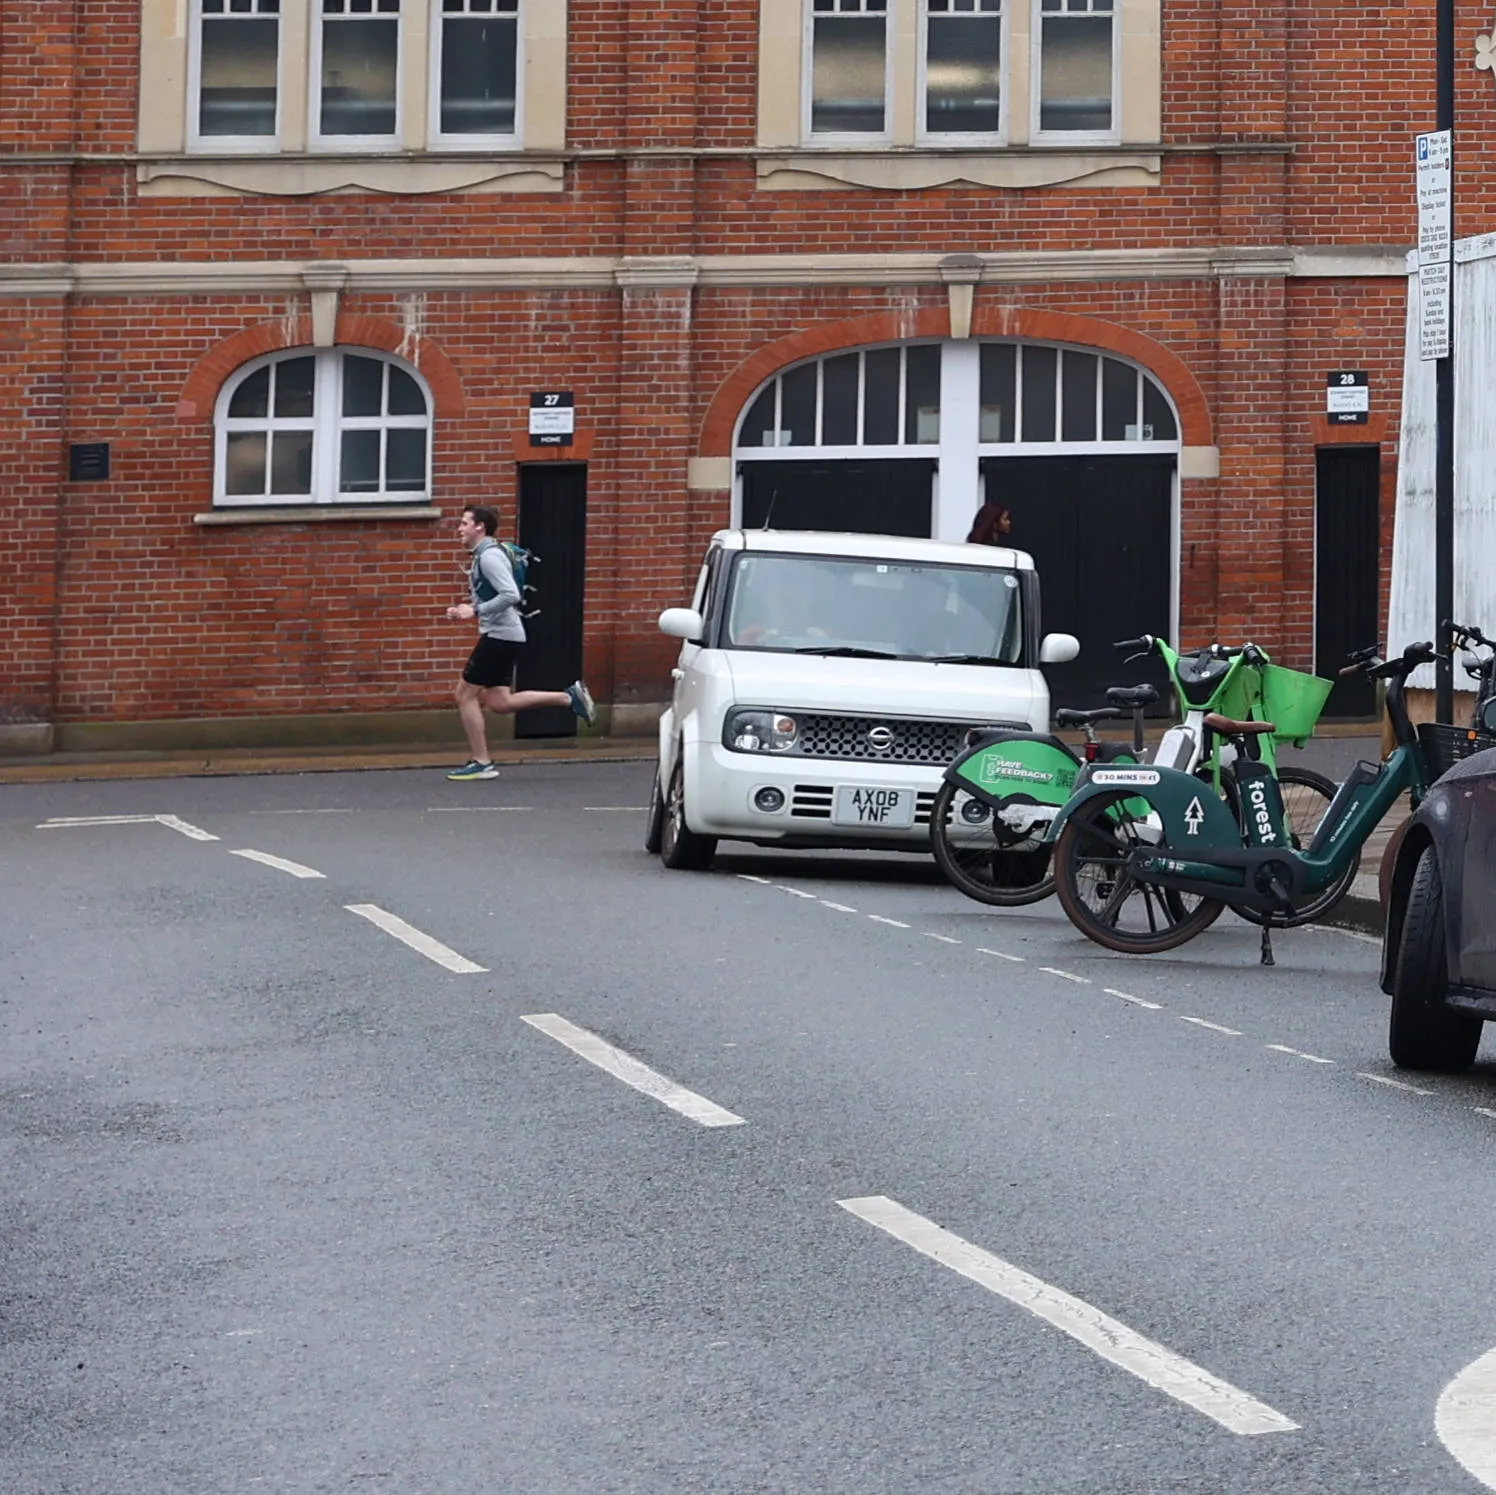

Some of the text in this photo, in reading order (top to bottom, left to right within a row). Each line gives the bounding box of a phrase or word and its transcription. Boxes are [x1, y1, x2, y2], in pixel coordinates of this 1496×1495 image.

[1340, 373, 1355, 385] 28
[544, 394, 560, 406] 27
[996, 760, 1022, 768] HAVE
[994, 767, 1053, 780] FEEDBACK?
[1116, 773, 1138, 781] MINS
[852, 788, 899, 807] AX08
[857, 805, 891, 822] YNF
[1248, 780, 1277, 843] forest
